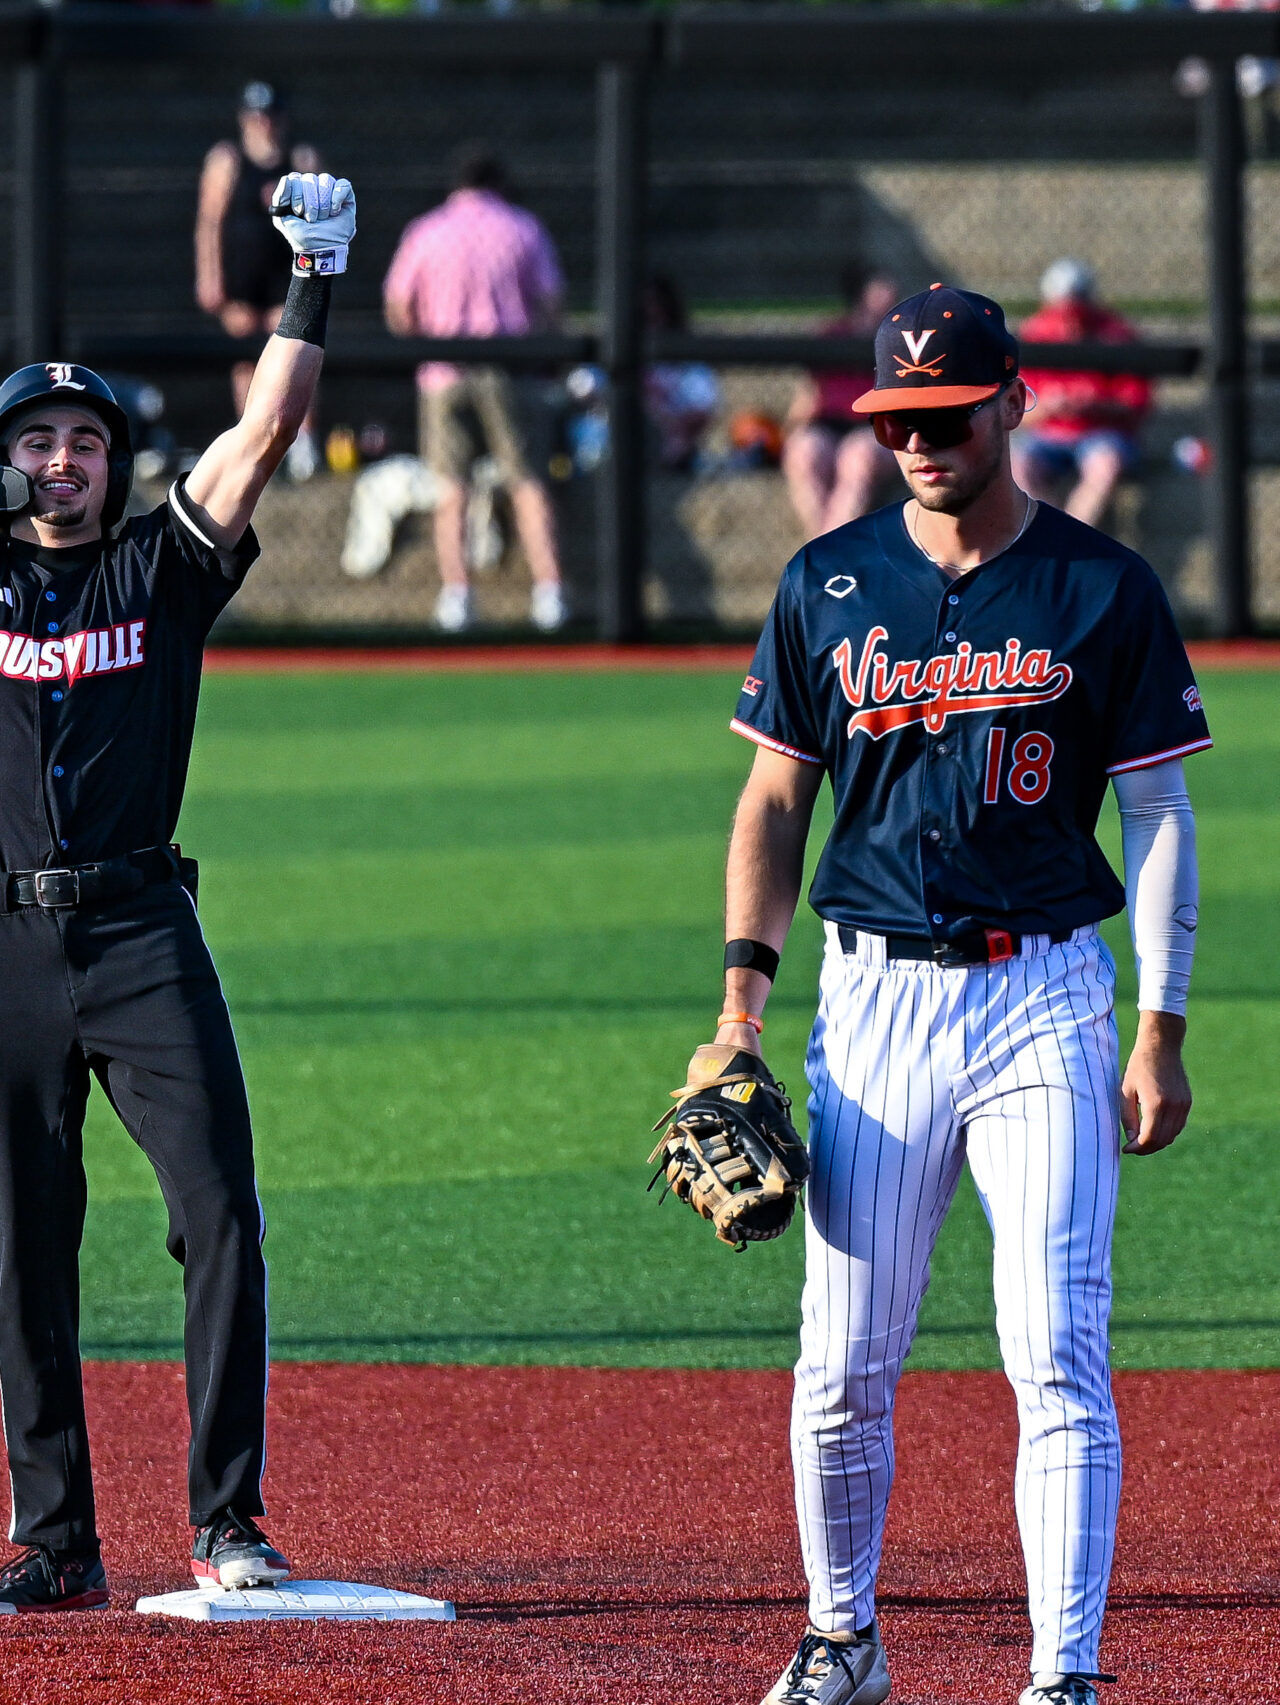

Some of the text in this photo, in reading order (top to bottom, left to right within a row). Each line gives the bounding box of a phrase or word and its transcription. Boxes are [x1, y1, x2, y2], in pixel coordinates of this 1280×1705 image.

[901, 329, 937, 366] V
[45, 362, 86, 391] L
[832, 626, 1073, 740] Virginia
[983, 727, 1055, 805] 18
